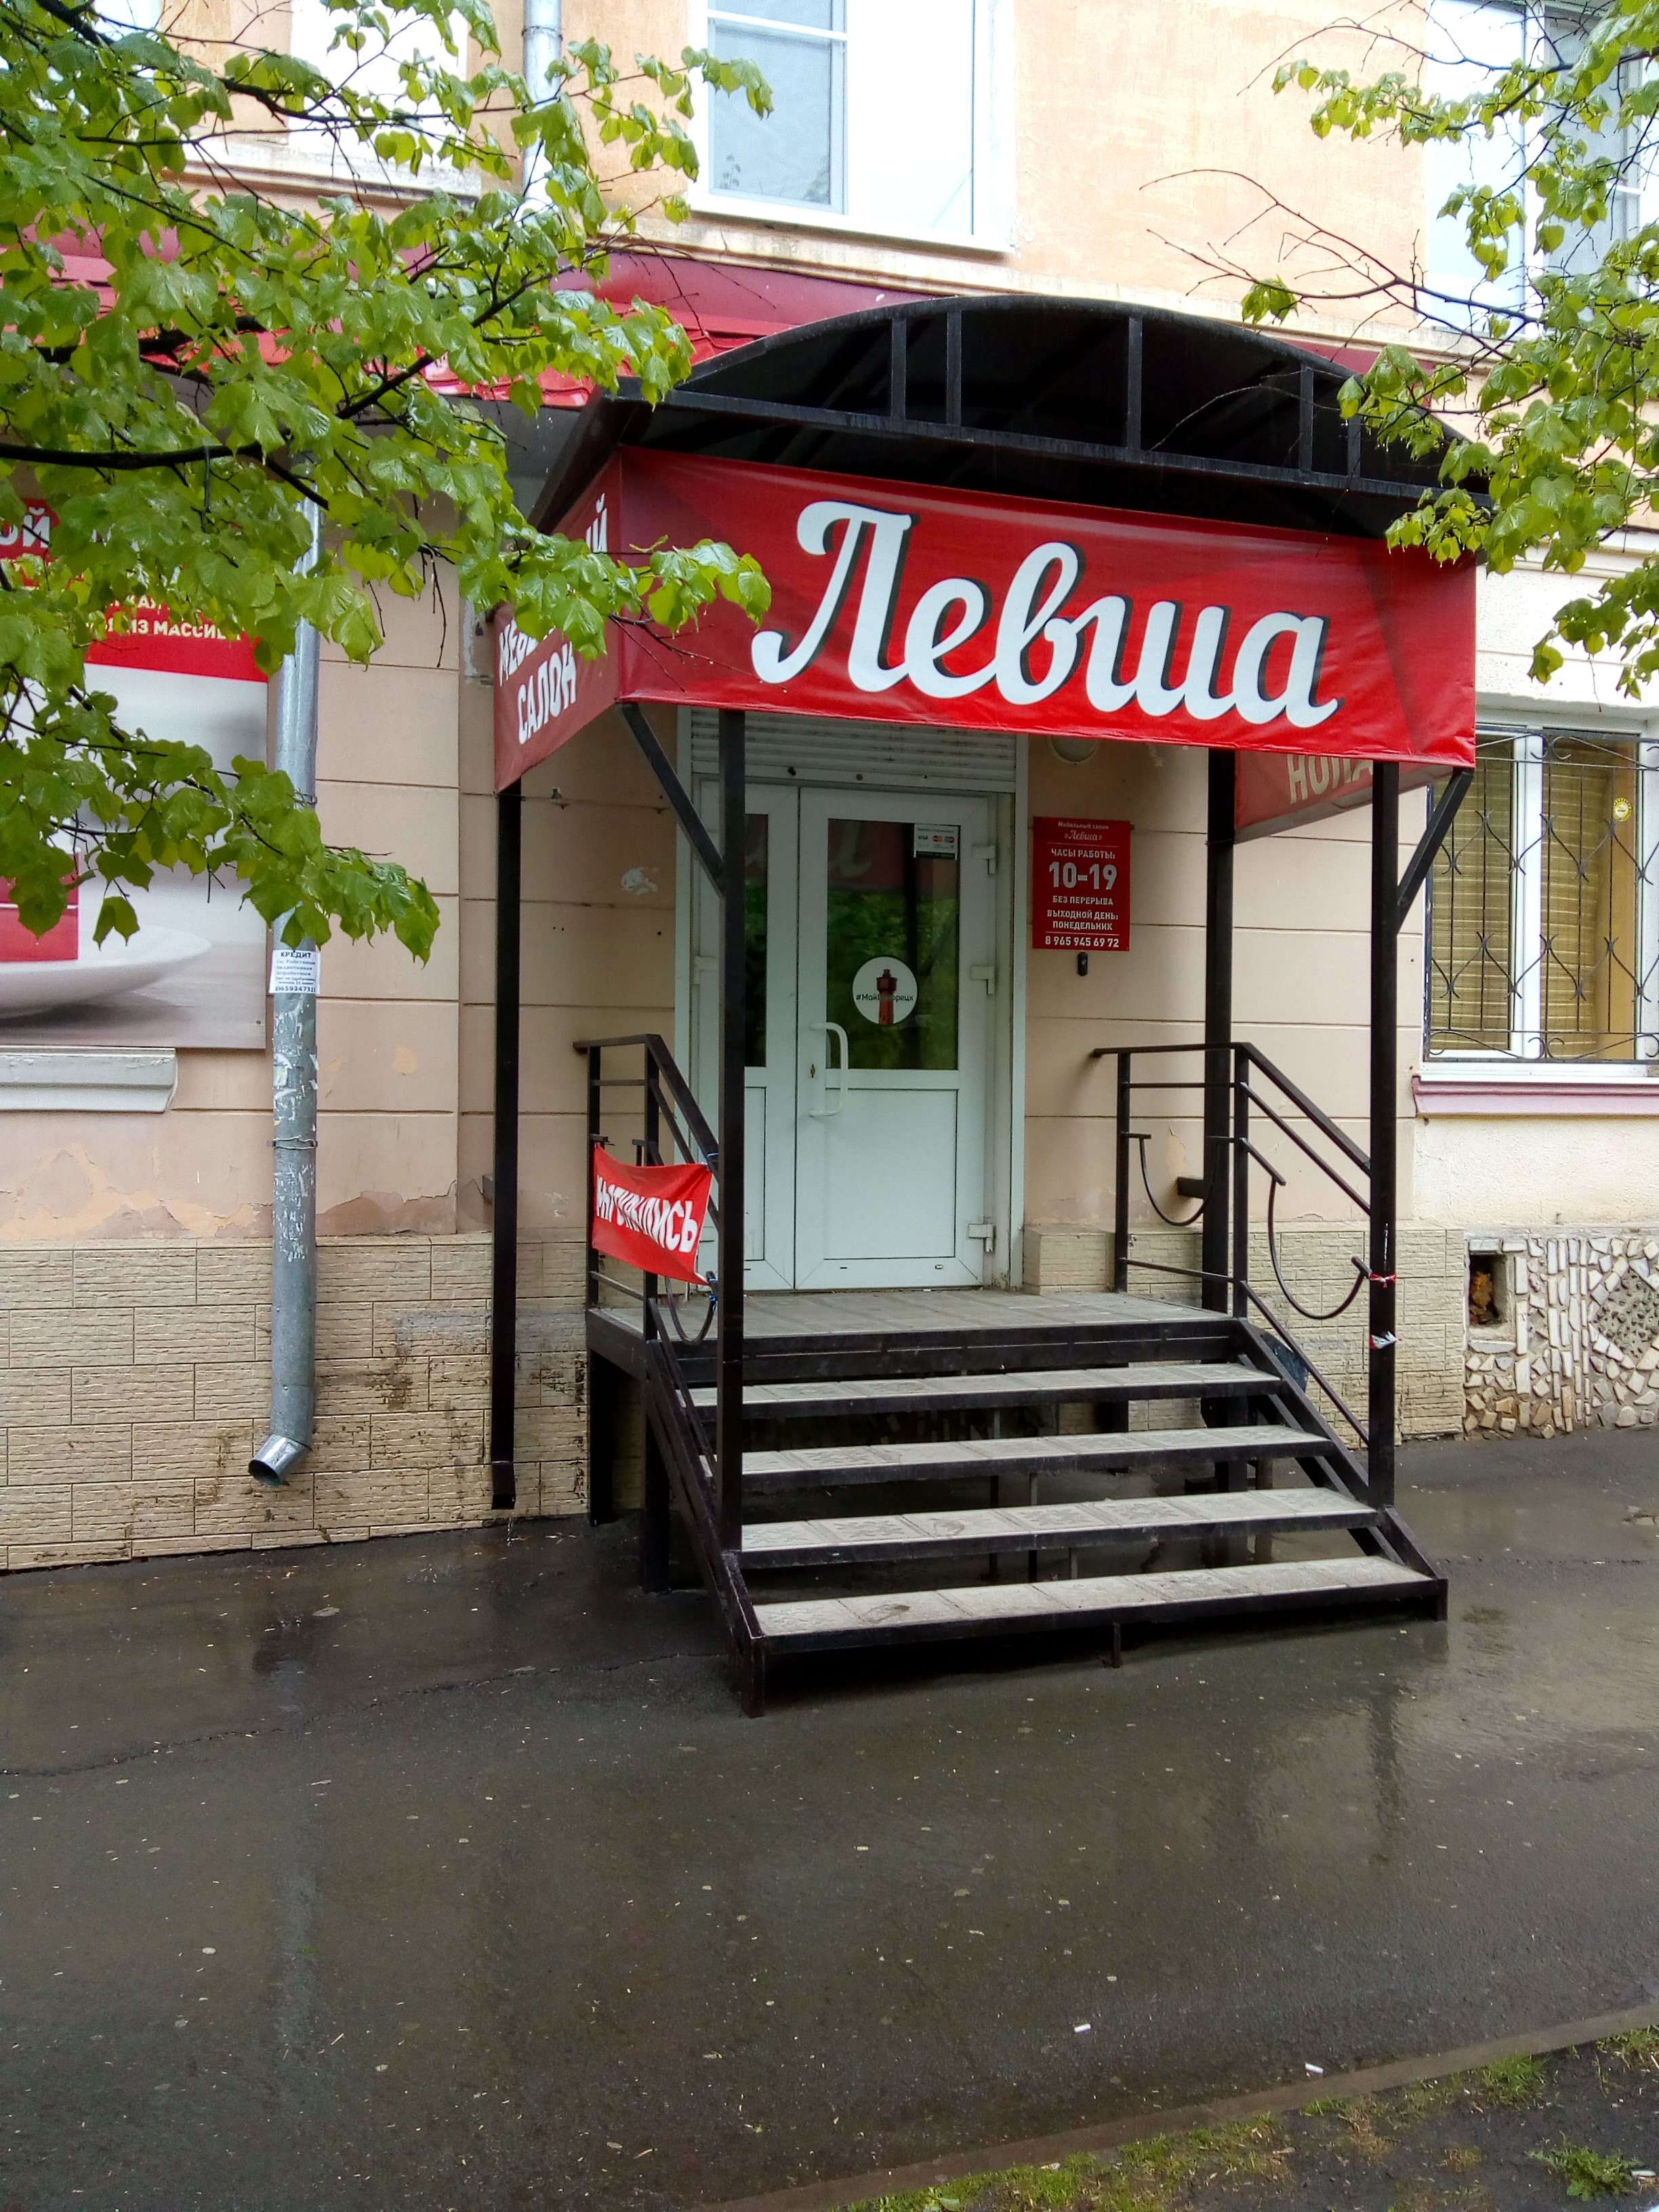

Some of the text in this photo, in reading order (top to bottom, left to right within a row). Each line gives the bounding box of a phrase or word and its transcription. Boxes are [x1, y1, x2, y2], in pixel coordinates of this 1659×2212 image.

[751, 500, 1345, 729] Левша
[518, 642, 577, 745] САЛОН
[1050, 848, 1115, 859] ЧАСЫ РАБОТЫ:
[1048, 861, 1118, 890] 10-19
[1052, 895, 1113, 905] БЕЗ ПЕРЕРЫВА
[1047, 909, 1118, 920] ВЫХОДНОЙ ДЕНЬ:
[1052, 920, 1113, 930] ПОНЕДЕЛЬНИК
[1045, 935, 1119, 948] 8 965 945 69 72
